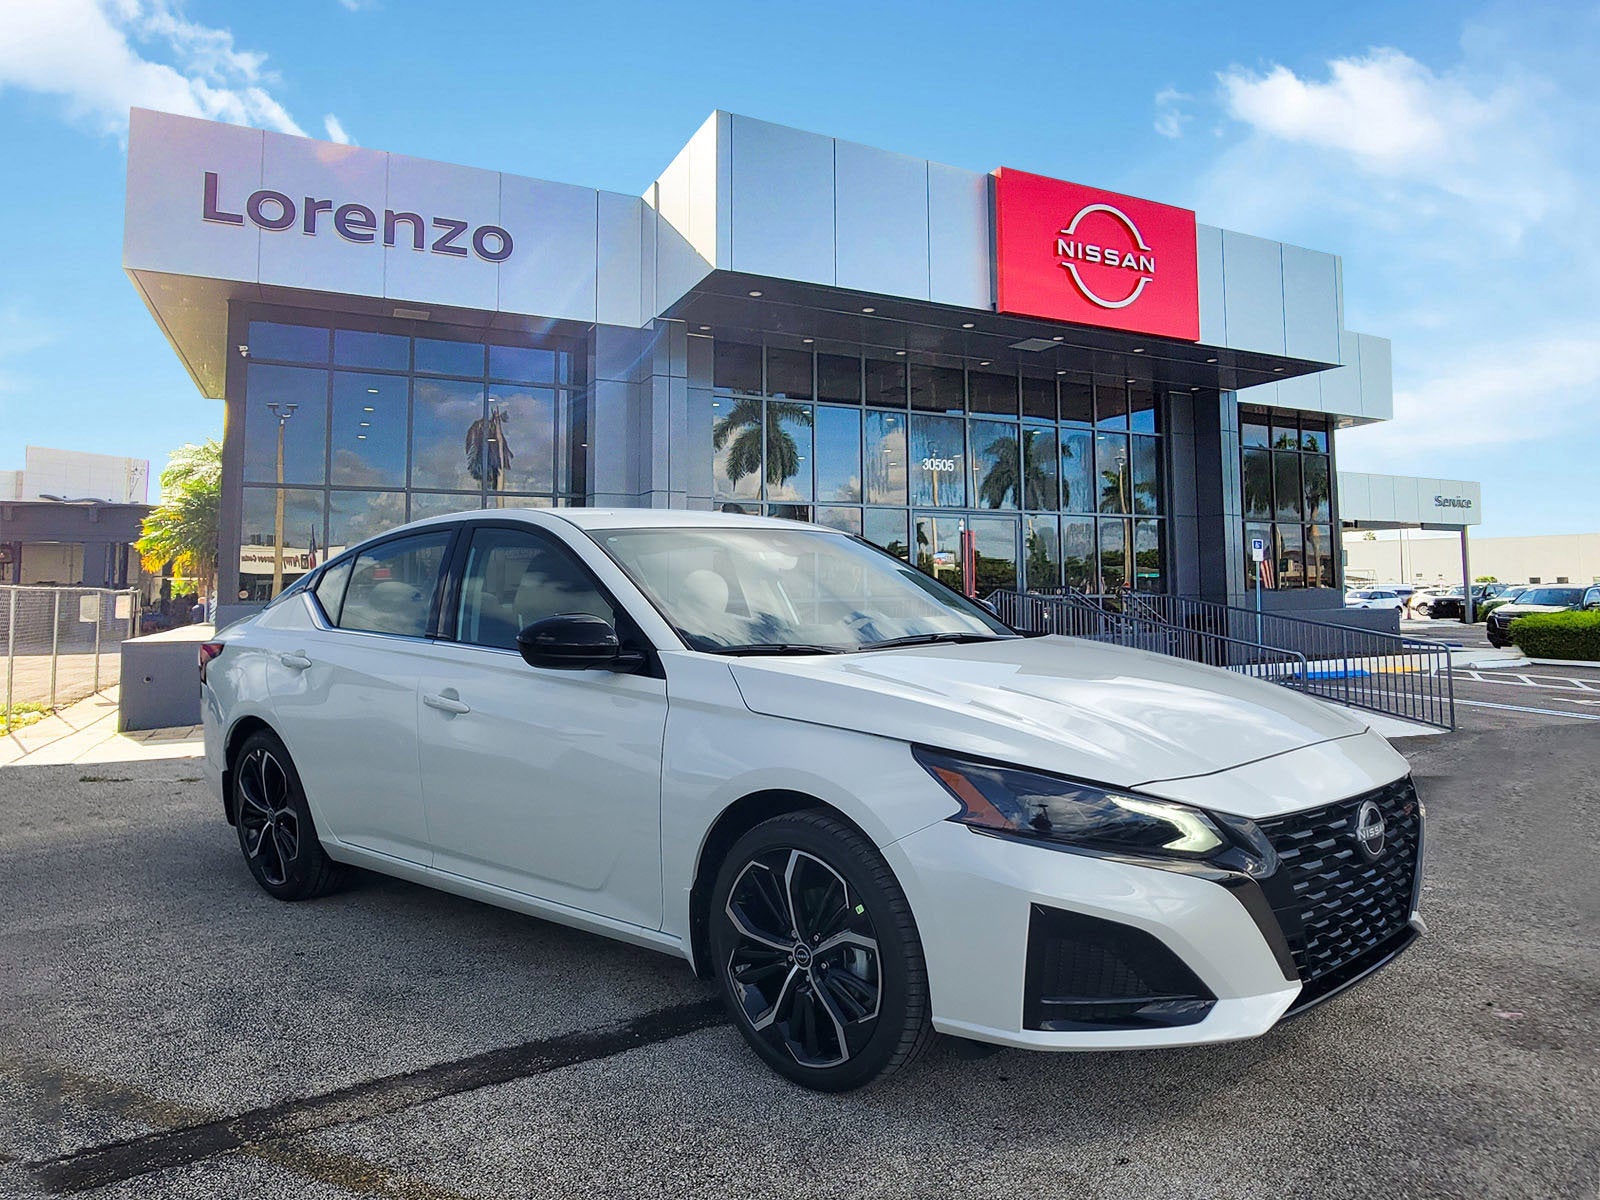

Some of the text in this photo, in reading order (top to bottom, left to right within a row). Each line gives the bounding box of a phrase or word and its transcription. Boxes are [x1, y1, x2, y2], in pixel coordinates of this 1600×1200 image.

[202, 171, 514, 262] Lorenzo
[1057, 238, 1155, 273] NISSAN
[922, 458, 955, 471] 30505
[1434, 495, 1472, 509] Service
[1356, 822, 1385, 840] NISS
